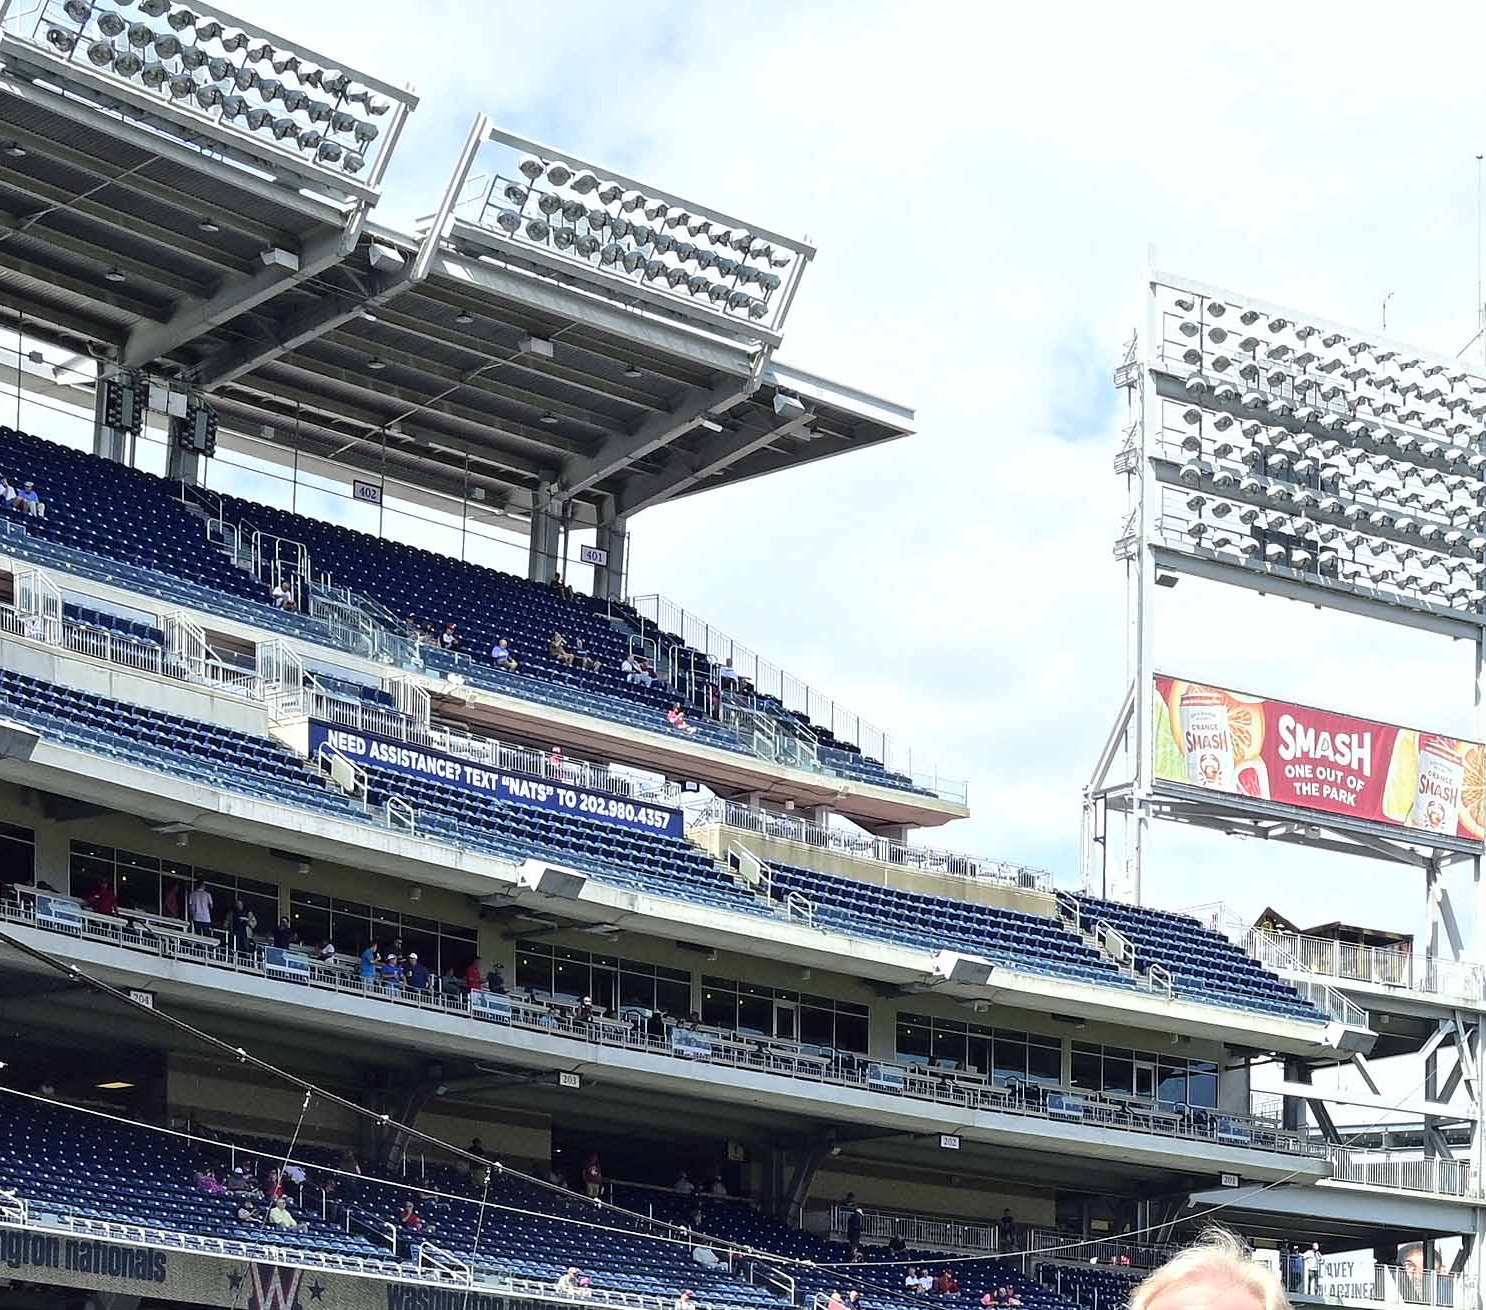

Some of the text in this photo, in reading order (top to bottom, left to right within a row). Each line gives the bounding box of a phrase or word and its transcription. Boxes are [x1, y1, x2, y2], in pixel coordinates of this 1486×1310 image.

[1186, 730, 1228, 752] SMASH
[1278, 714, 1372, 778] SMASH
[327, 729, 366, 756] NEED
[369, 741, 462, 781] ASSISTANCE?
[463, 766, 499, 791] TEXT
[556, 788, 577, 808] TO
[579, 793, 671, 830] 202.980.4357
[1285, 763, 1365, 792] ONE OUT OF
[1419, 774, 1458, 808] SMASH
[1293, 782, 1357, 807] THE PARK
[563, 1073, 579, 1086] 203
